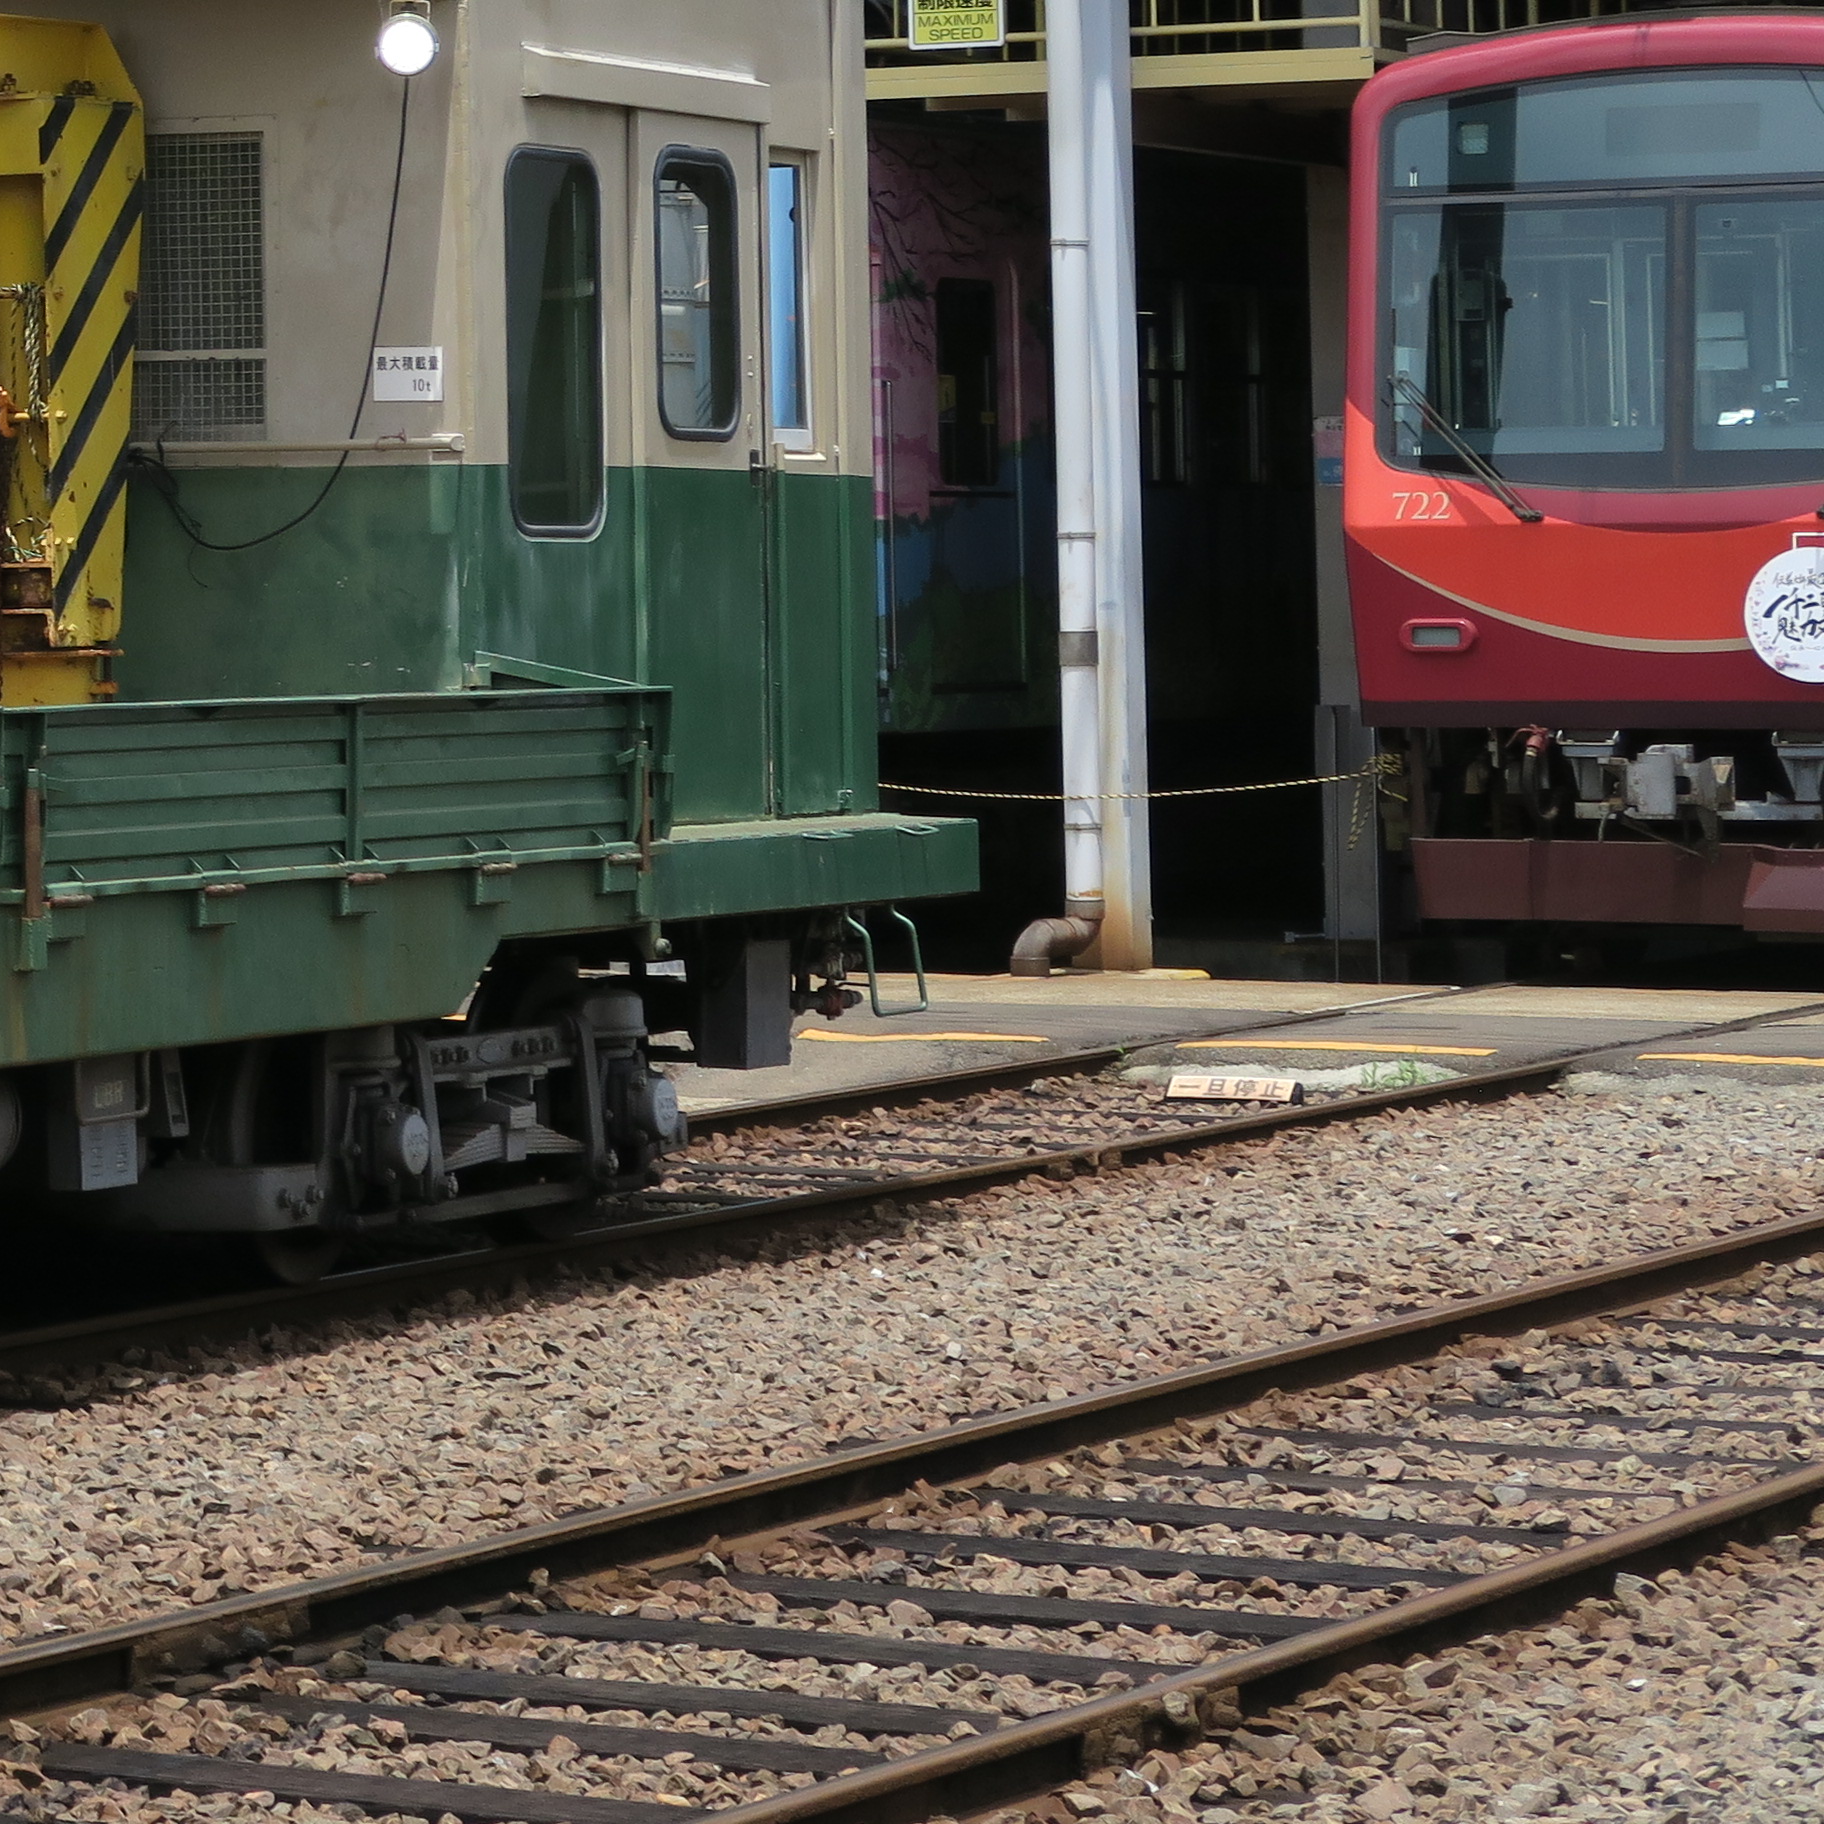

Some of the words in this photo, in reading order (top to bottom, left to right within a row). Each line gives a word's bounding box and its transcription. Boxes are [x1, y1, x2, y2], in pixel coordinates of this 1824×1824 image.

[918, 12, 994, 28] MAXIMUM
[928, 27, 984, 41] SPEED
[376, 356, 439, 371] 最大積載量
[1392, 491, 1451, 520] 722
[1178, 1078, 1285, 1099] 一旦停止
